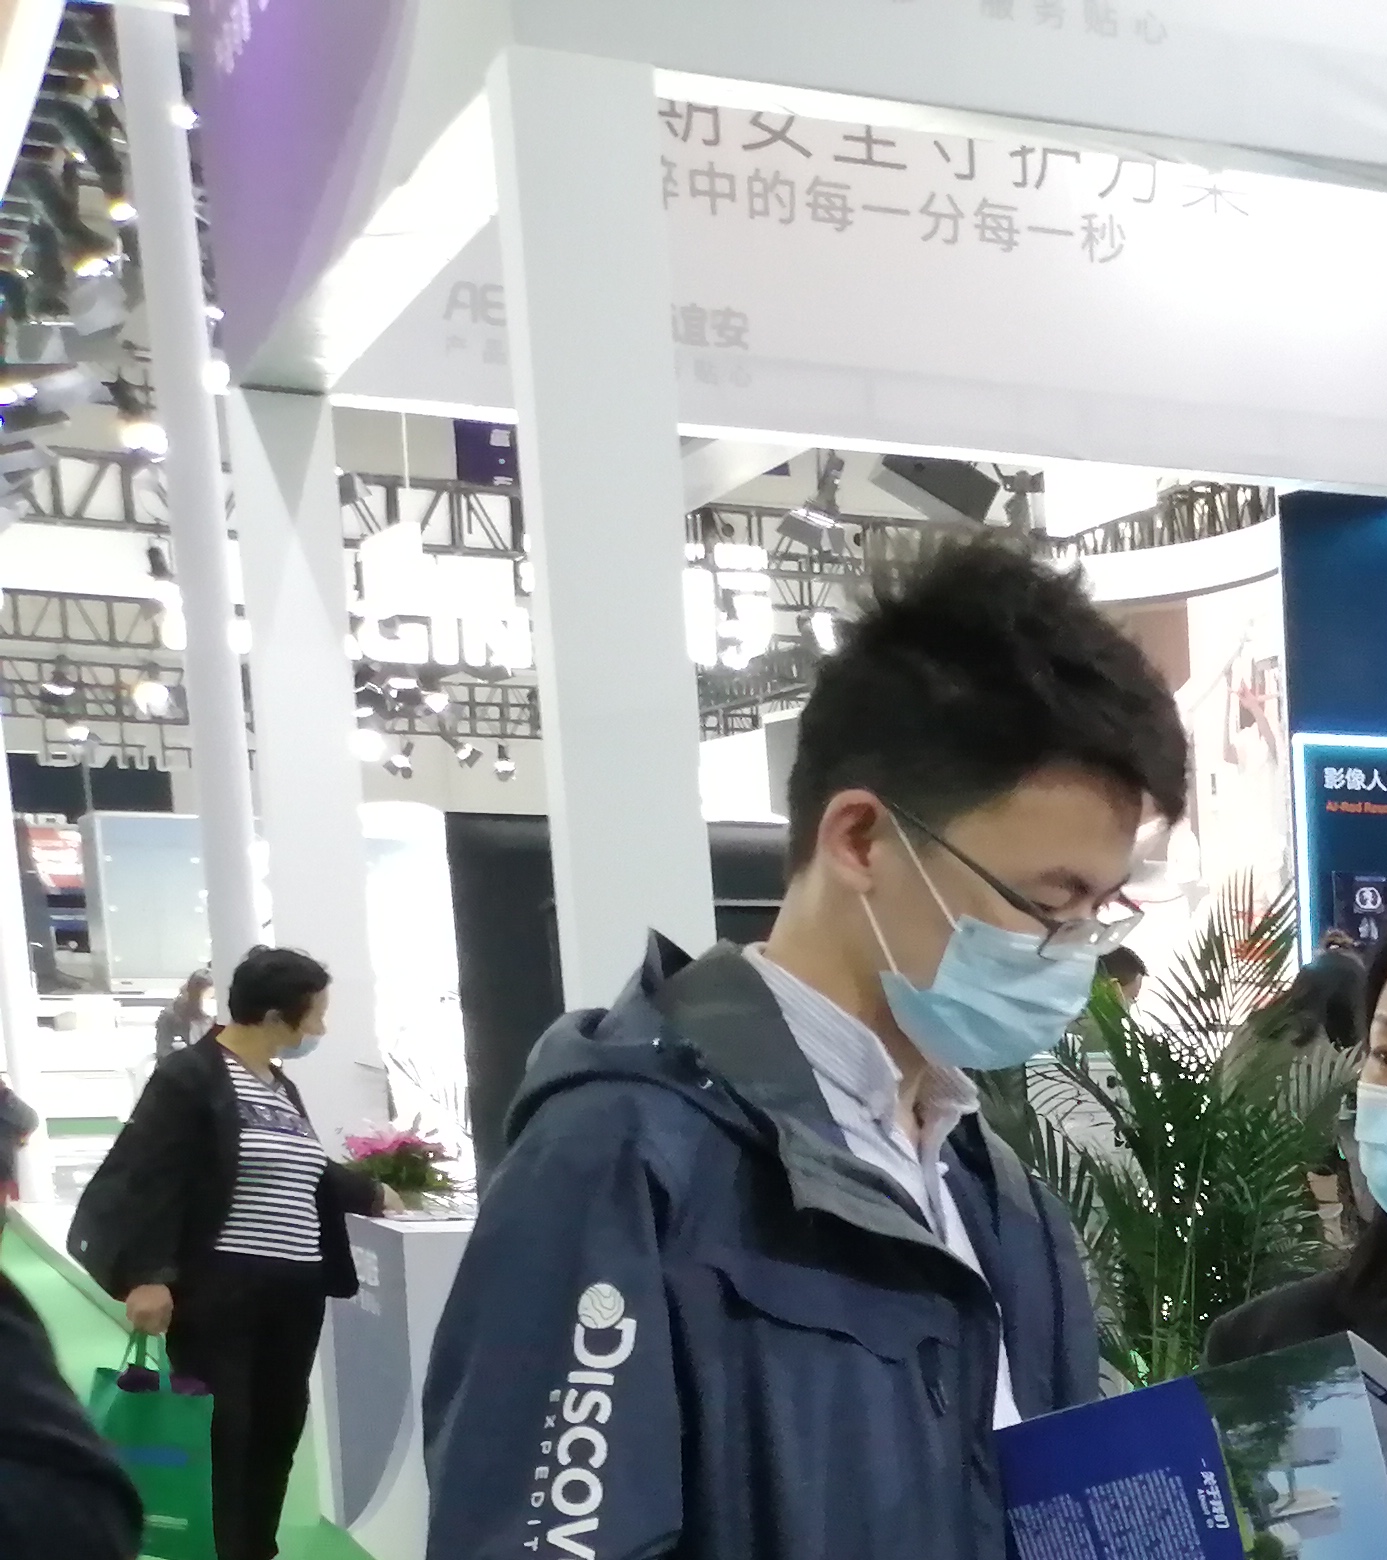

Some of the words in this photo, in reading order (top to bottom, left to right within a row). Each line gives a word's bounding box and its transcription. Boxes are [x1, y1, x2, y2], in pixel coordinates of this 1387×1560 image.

[661, 155, 1126, 263] 中的每一分每一秒
